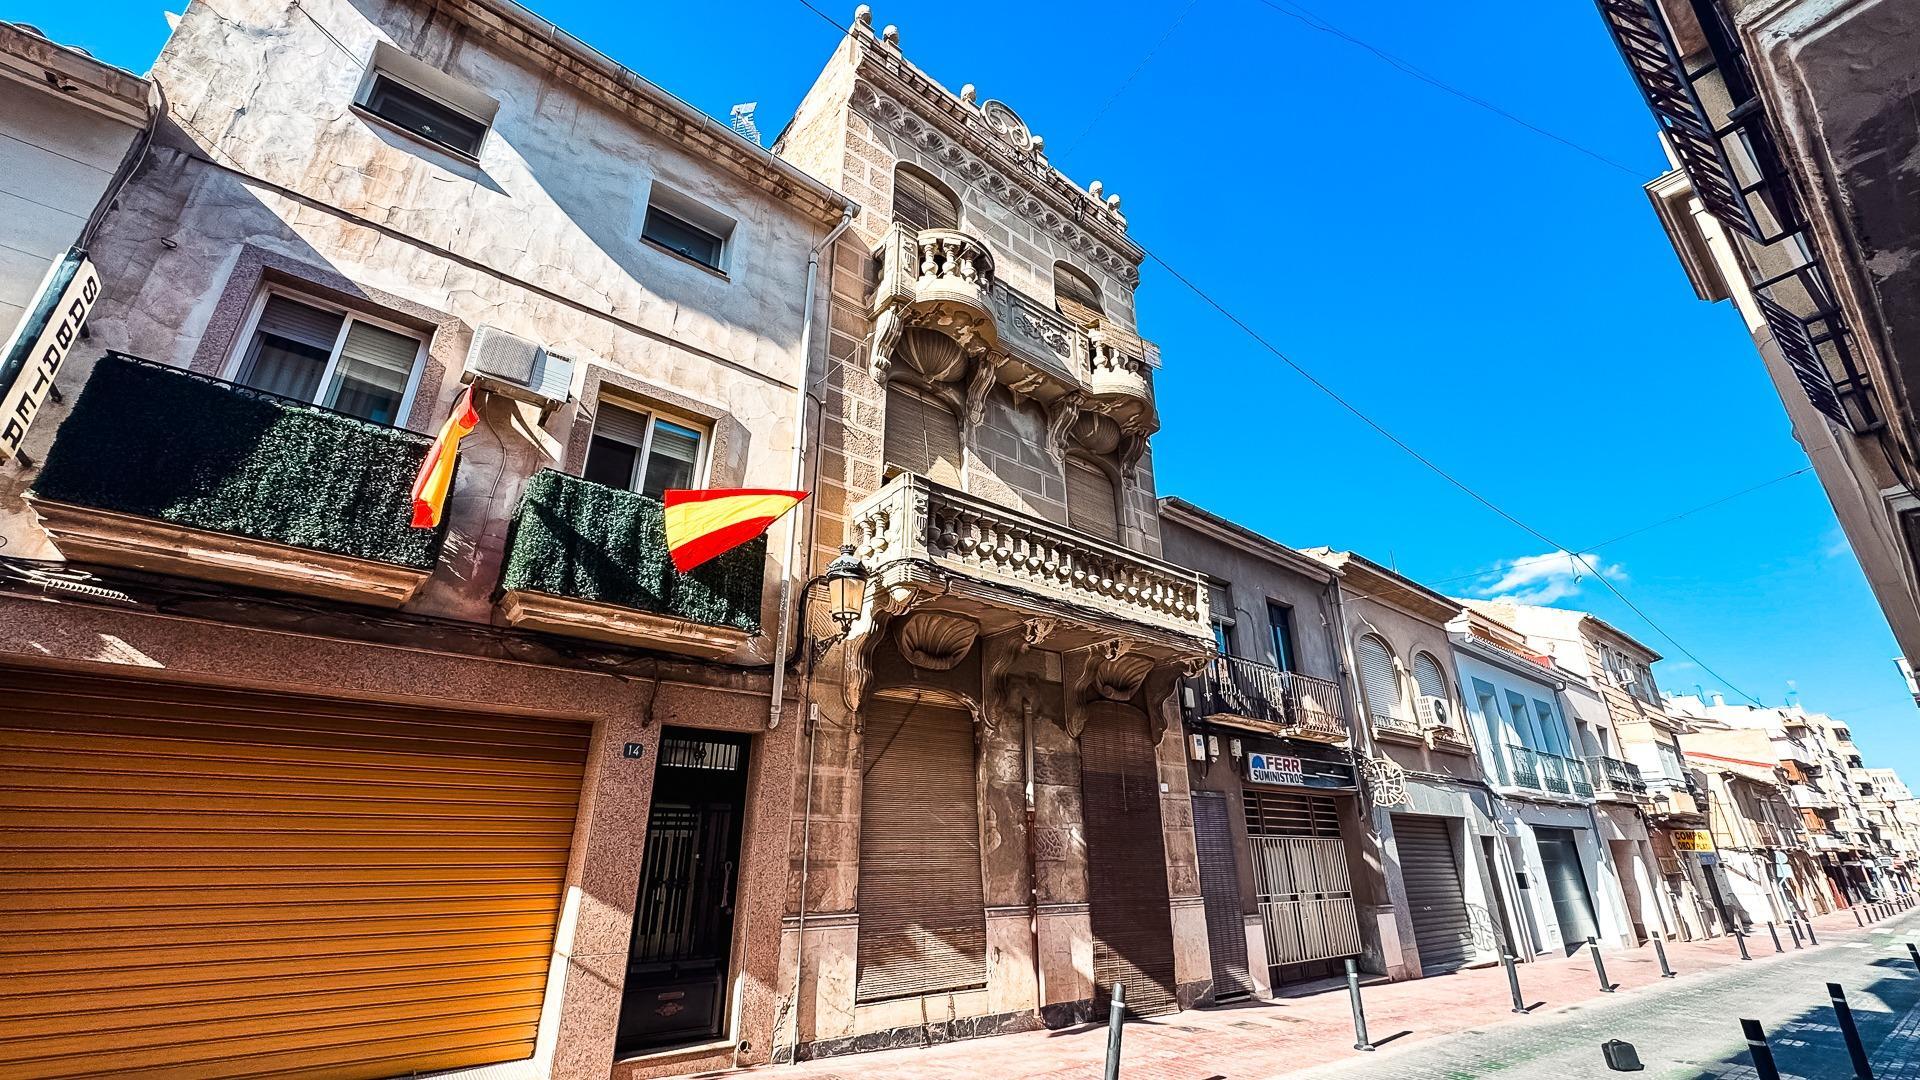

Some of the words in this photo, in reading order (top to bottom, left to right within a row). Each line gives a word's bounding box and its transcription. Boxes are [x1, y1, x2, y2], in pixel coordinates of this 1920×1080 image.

[1, 275, 98, 450] SABATER
[628, 744, 641, 756] 14
[1265, 756, 1300, 773] FERR
[1253, 769, 1304, 784] SUMINISTROS
[1674, 831, 1708, 841] COMPR
